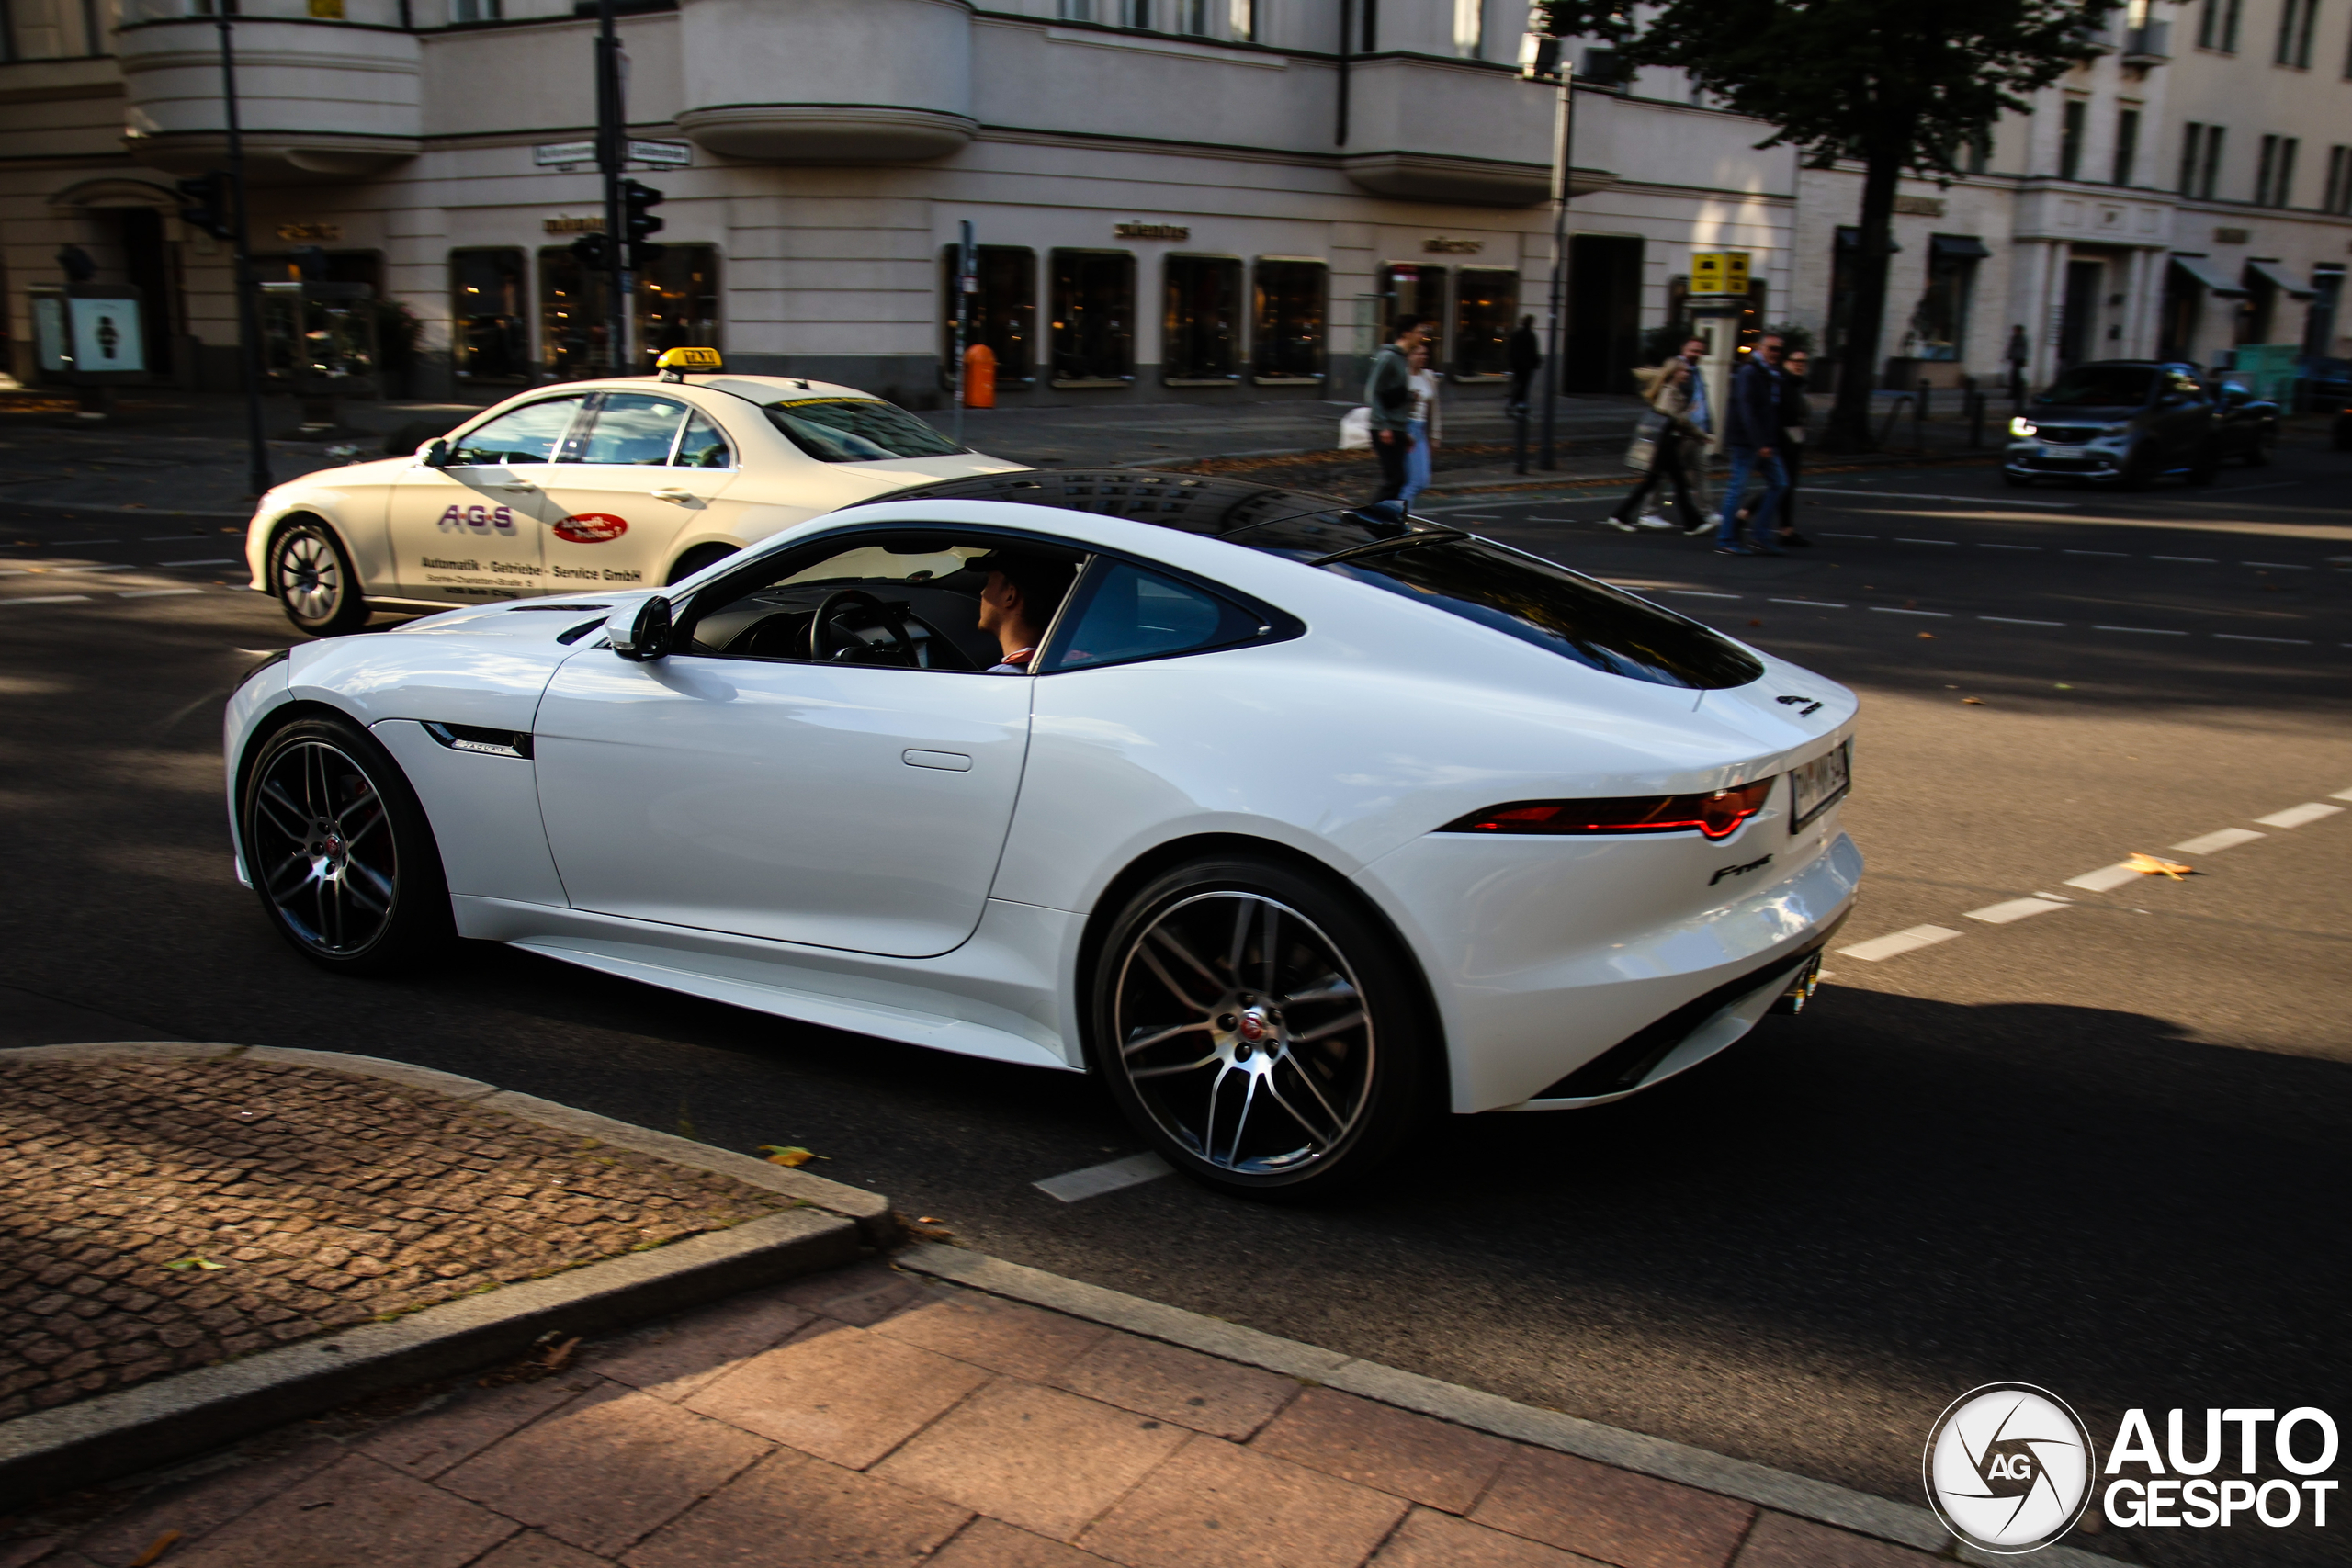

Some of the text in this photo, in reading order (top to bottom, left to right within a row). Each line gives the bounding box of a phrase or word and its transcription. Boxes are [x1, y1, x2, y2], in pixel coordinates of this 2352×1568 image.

[684, 350, 715, 364] TAXI
[422, 556, 481, 571] Automatik
[490, 560, 542, 576] Getriebe
[553, 565, 600, 580] Service
[603, 568, 642, 582] GmbH
[463, 742, 505, 753] JAGUAR
